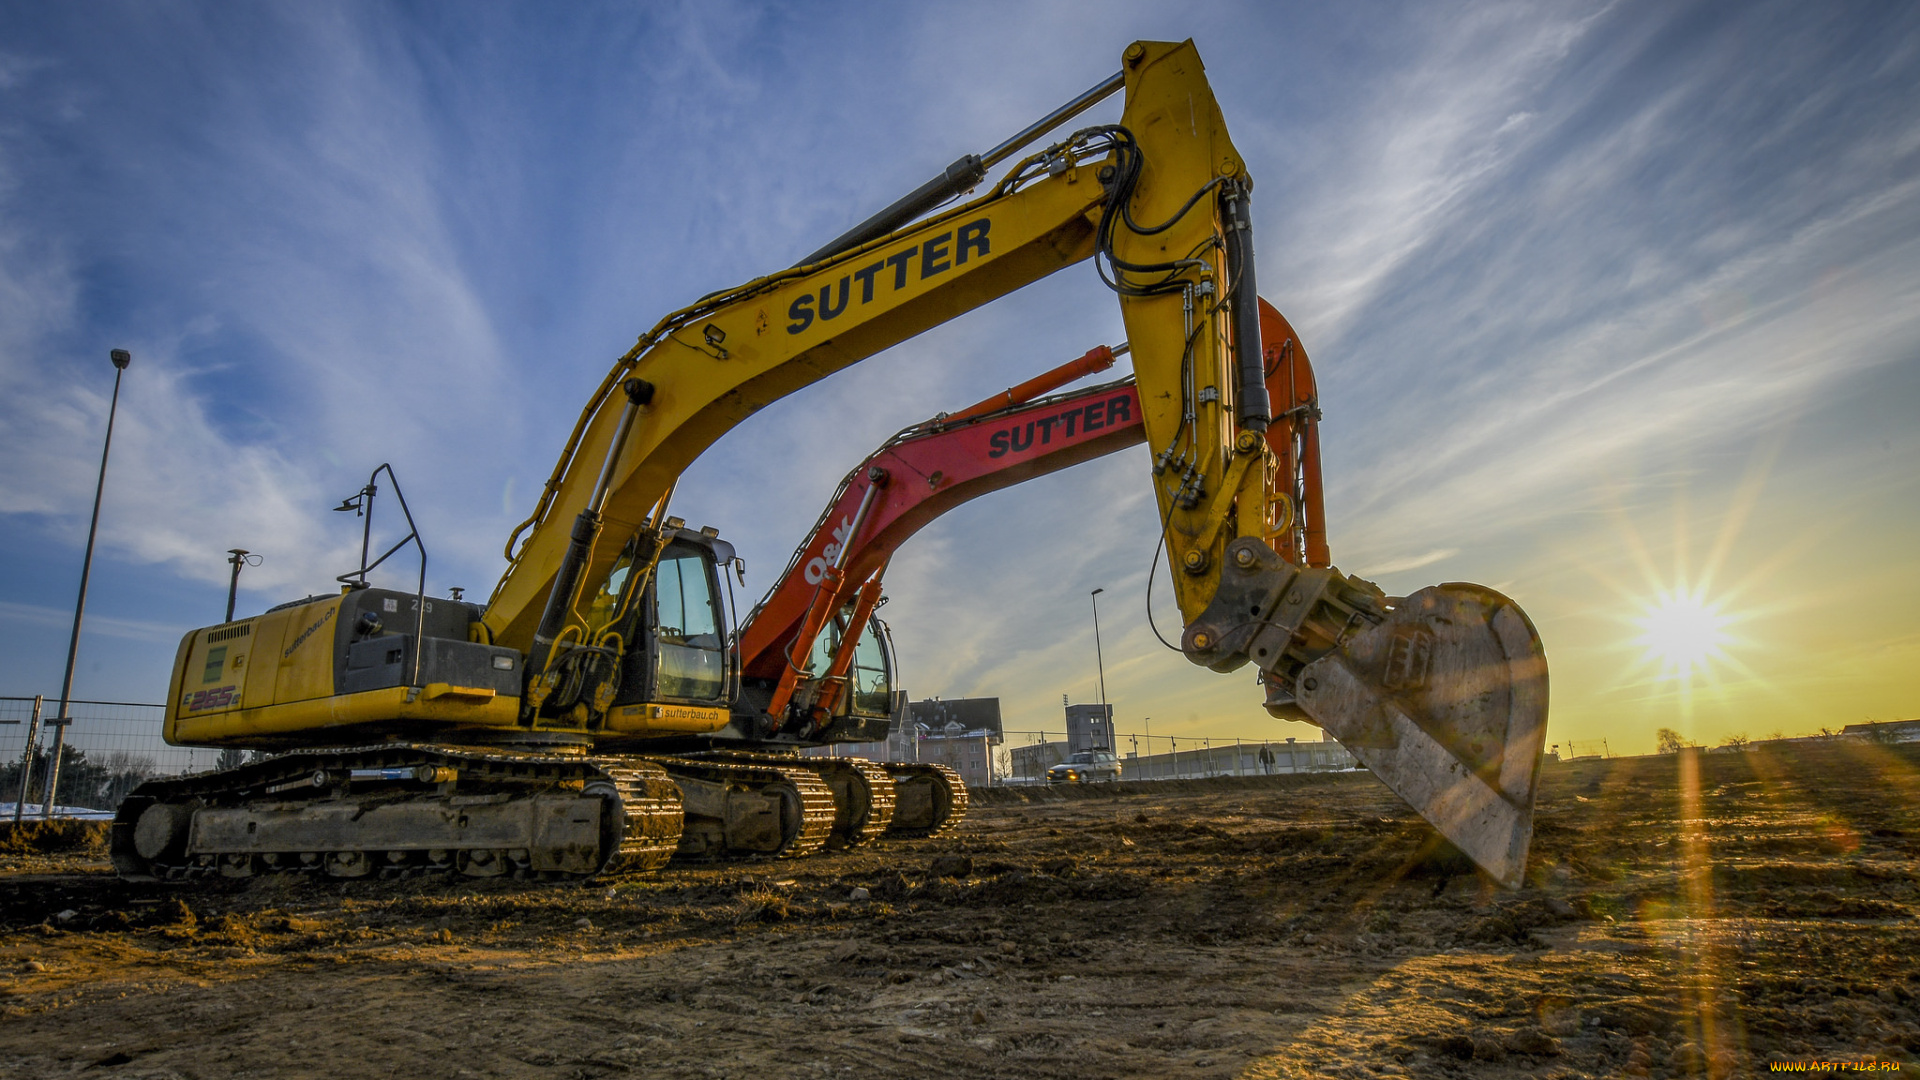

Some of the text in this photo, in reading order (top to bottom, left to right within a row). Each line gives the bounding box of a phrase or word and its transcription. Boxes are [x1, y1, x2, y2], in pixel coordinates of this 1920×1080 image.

[787, 217, 991, 335] SUTTER
[988, 394, 1132, 459] SUTTER
[804, 515, 853, 585] O&K
[284, 606, 336, 659] sutterbau.ch
[411, 599, 433, 613] 29
[664, 708, 719, 720] sutterbau.ch
